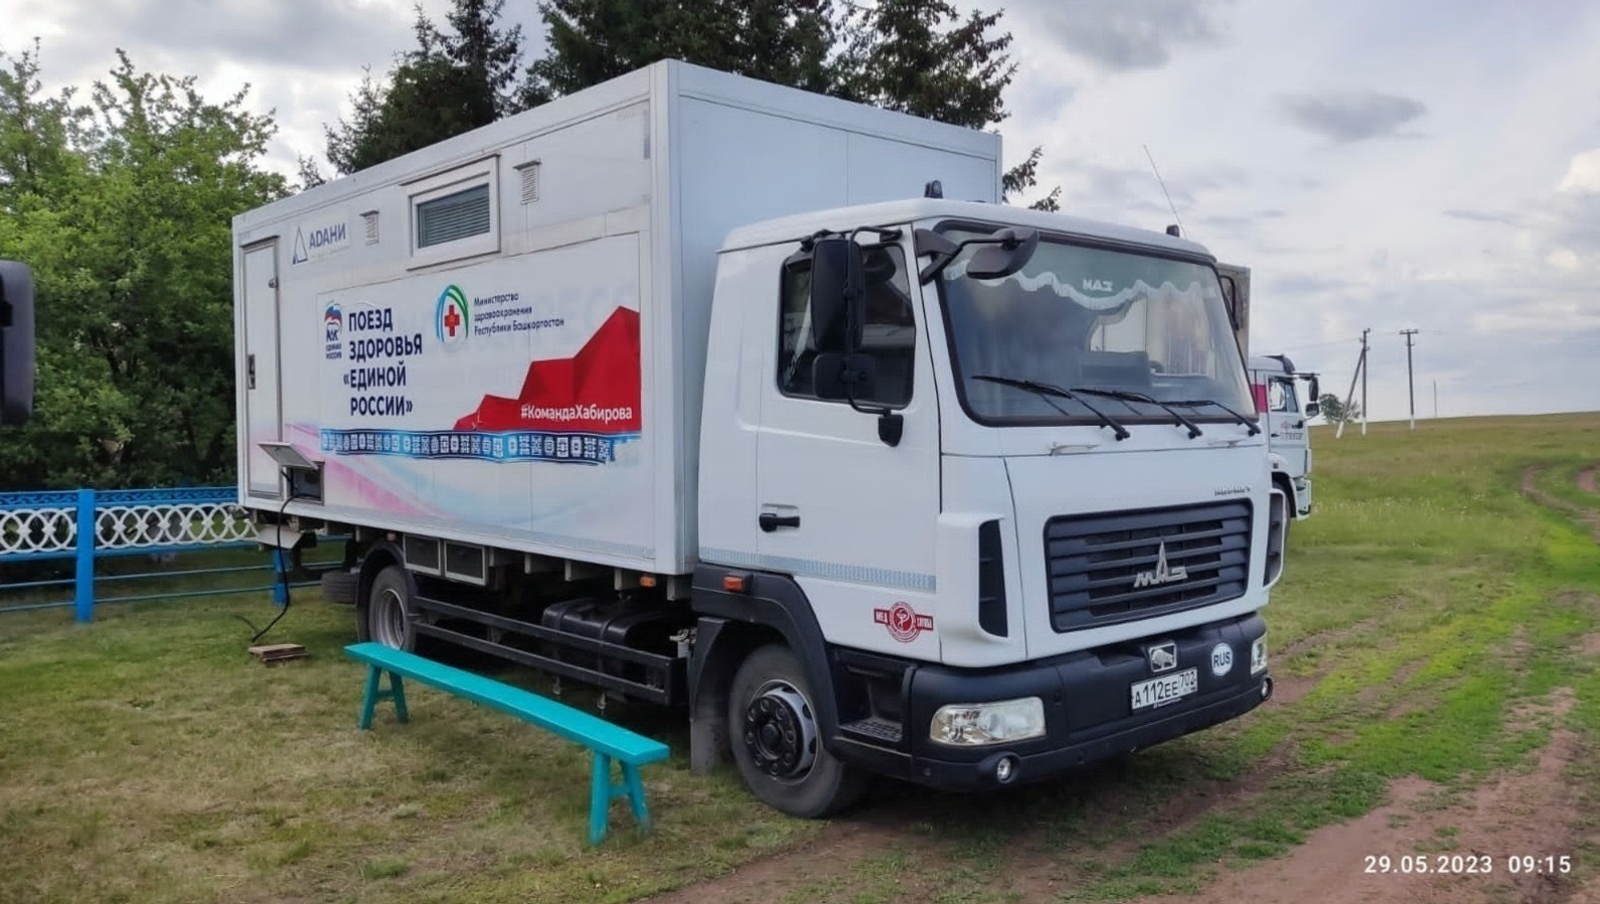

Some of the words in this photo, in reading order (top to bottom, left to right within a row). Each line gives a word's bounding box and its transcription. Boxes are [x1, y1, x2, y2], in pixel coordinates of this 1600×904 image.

[474, 293, 519, 306] Министерство
[348, 308, 393, 332] ПОЕЗД
[474, 306, 532, 323] здравоохранения
[474, 322, 511, 337] Республики
[513, 318, 565, 332] Башкортостан
[349, 333, 423, 362] ЗДОРОВЬЯ
[343, 361, 406, 391] «ЕДИНОЙ
[350, 396, 413, 416] РОССИИ»
[521, 403, 632, 424] #КомандаХабирова
[1212, 652, 1231, 668] RUS
